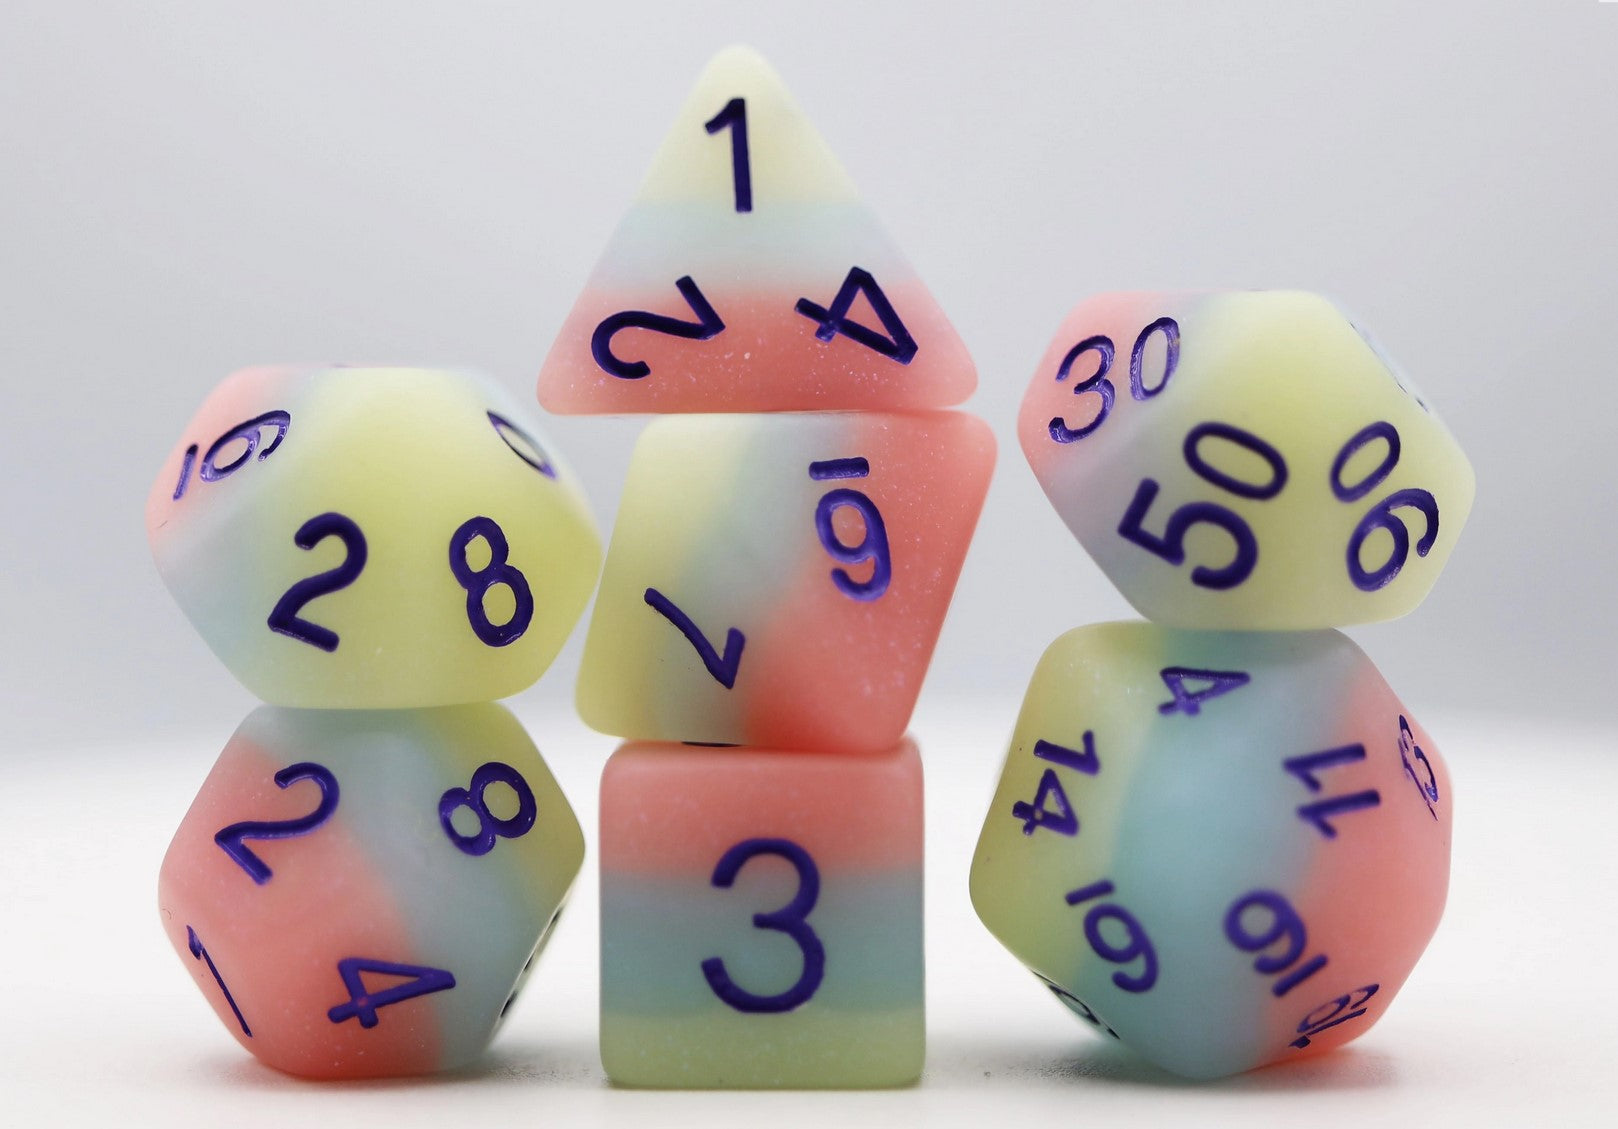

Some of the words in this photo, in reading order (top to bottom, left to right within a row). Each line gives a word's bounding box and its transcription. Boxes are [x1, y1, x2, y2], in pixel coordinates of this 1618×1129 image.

[705, 97, 753, 213] 1
[591, 275, 726, 380] 2
[794, 266, 918, 365] 4
[1048, 316, 1180, 444] 30
[1114, 421, 1289, 590] 50
[267, 512, 368, 653] 2
[449, 515, 534, 648] 8
[1158, 666, 1251, 716] 4
[214, 762, 340, 886] 2
[439, 762, 537, 856] 8
[1012, 730, 1101, 836] 14
[1283, 742, 1382, 840] 11
[702, 838, 826, 1013] 3
[327, 957, 457, 1029] 4
